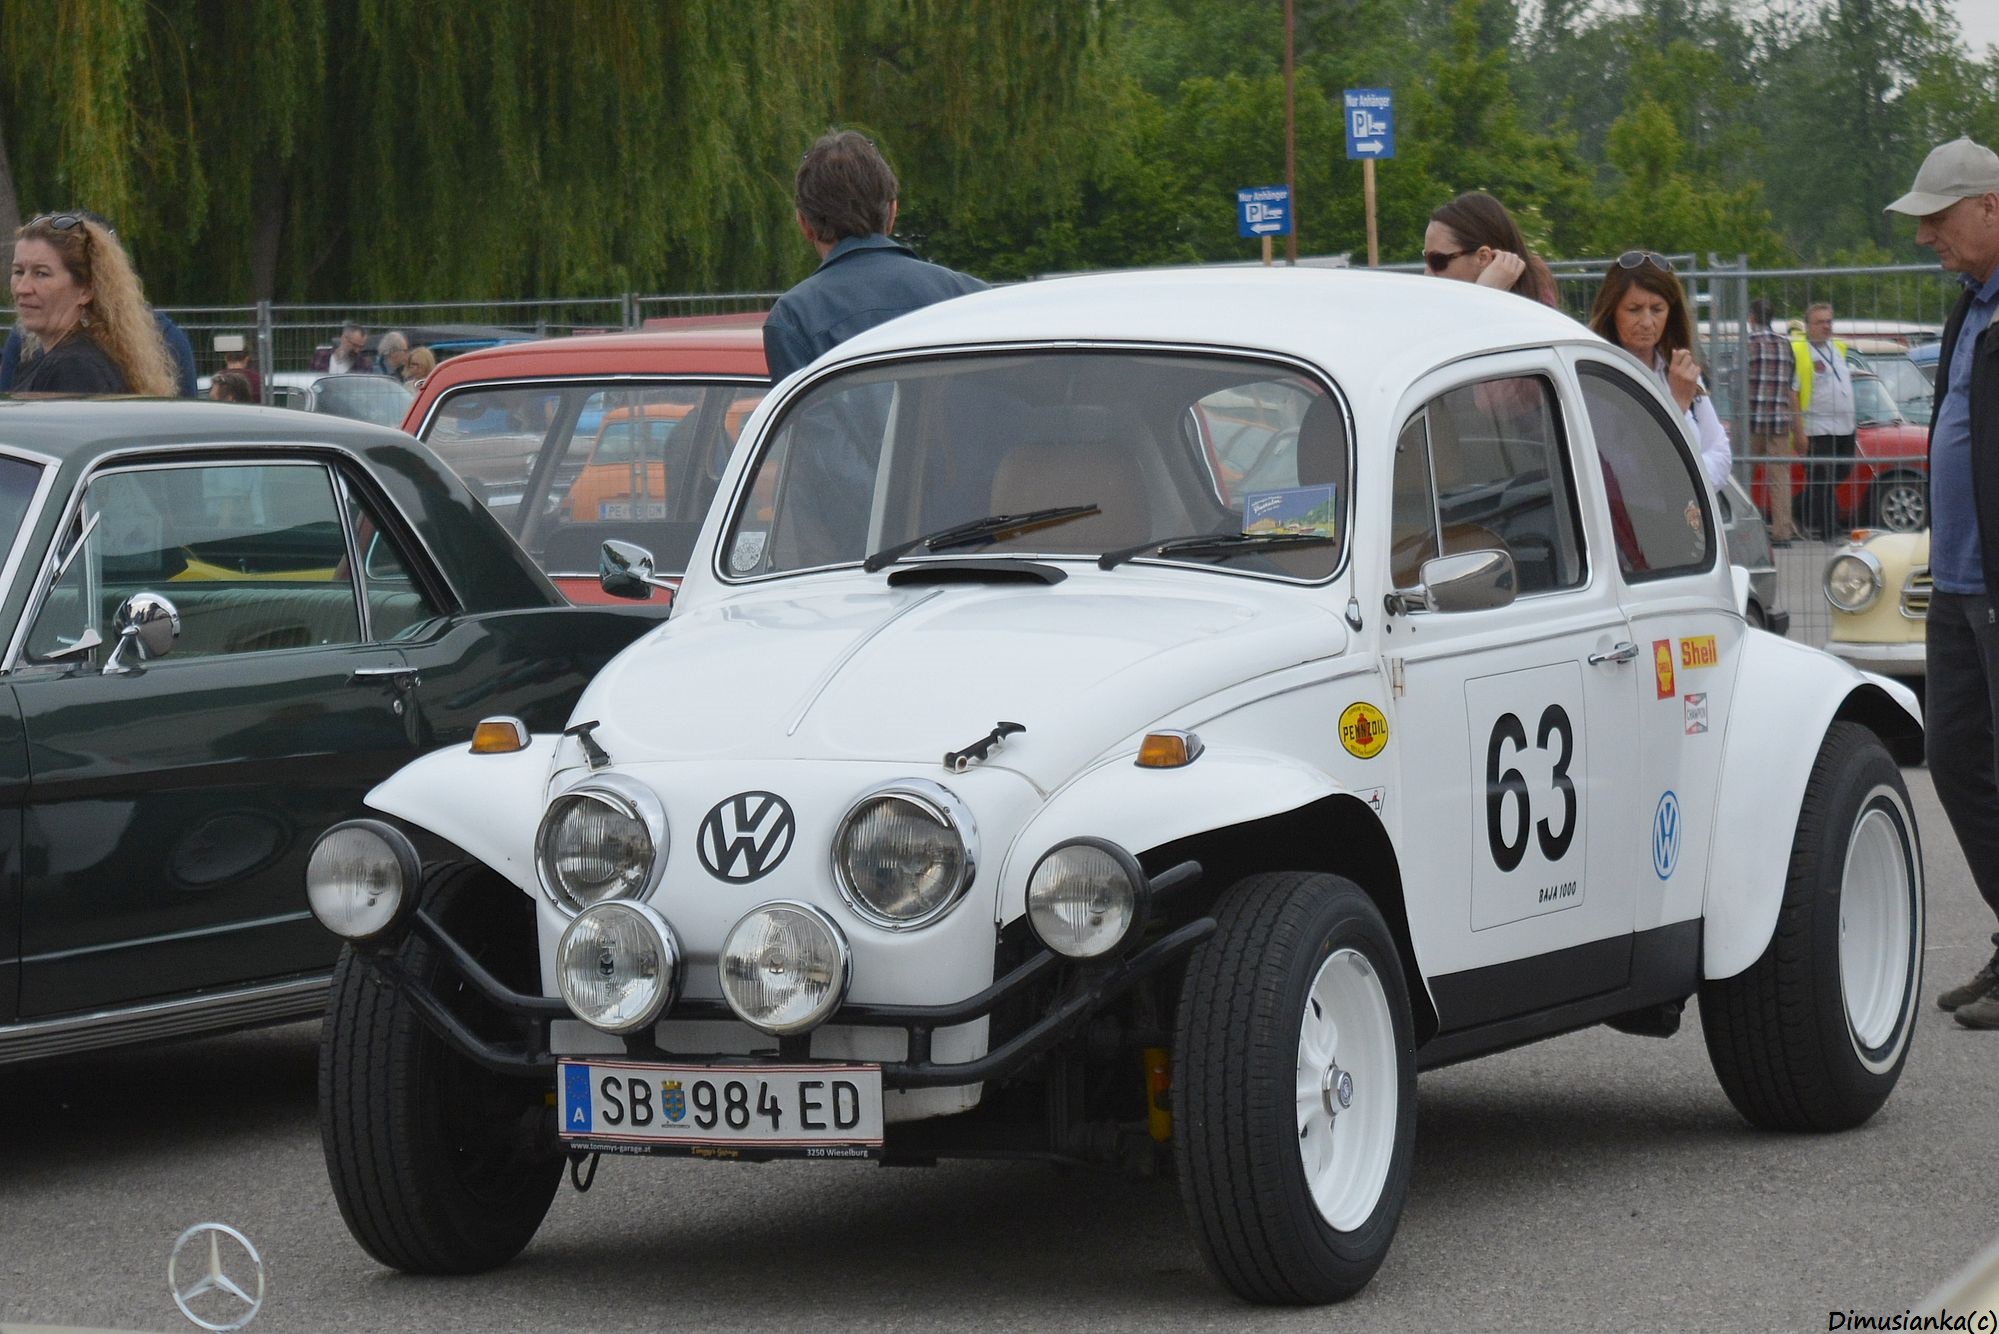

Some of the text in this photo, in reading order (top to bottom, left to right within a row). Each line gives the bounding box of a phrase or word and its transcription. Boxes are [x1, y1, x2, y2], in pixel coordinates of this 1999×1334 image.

[1345, 94, 1390, 110] Nur Anhänger
[1238, 190, 1287, 202] Nur Anhänger
[1681, 639, 1717, 667] Shell
[1343, 719, 1386, 742] PENNZOIL
[1486, 703, 1577, 873] 63
[697, 791, 795, 885] VW
[1653, 793, 1681, 878] VW
[1538, 881, 1577, 903] BAJA 1000
[600, 1075, 860, 1132] SB 984 ED
[573, 1107, 585, 1123] A
[570, 1142, 651, 1153] www.tommys-garage.at
[807, 1148, 869, 1159] 3250 Wieselburg
